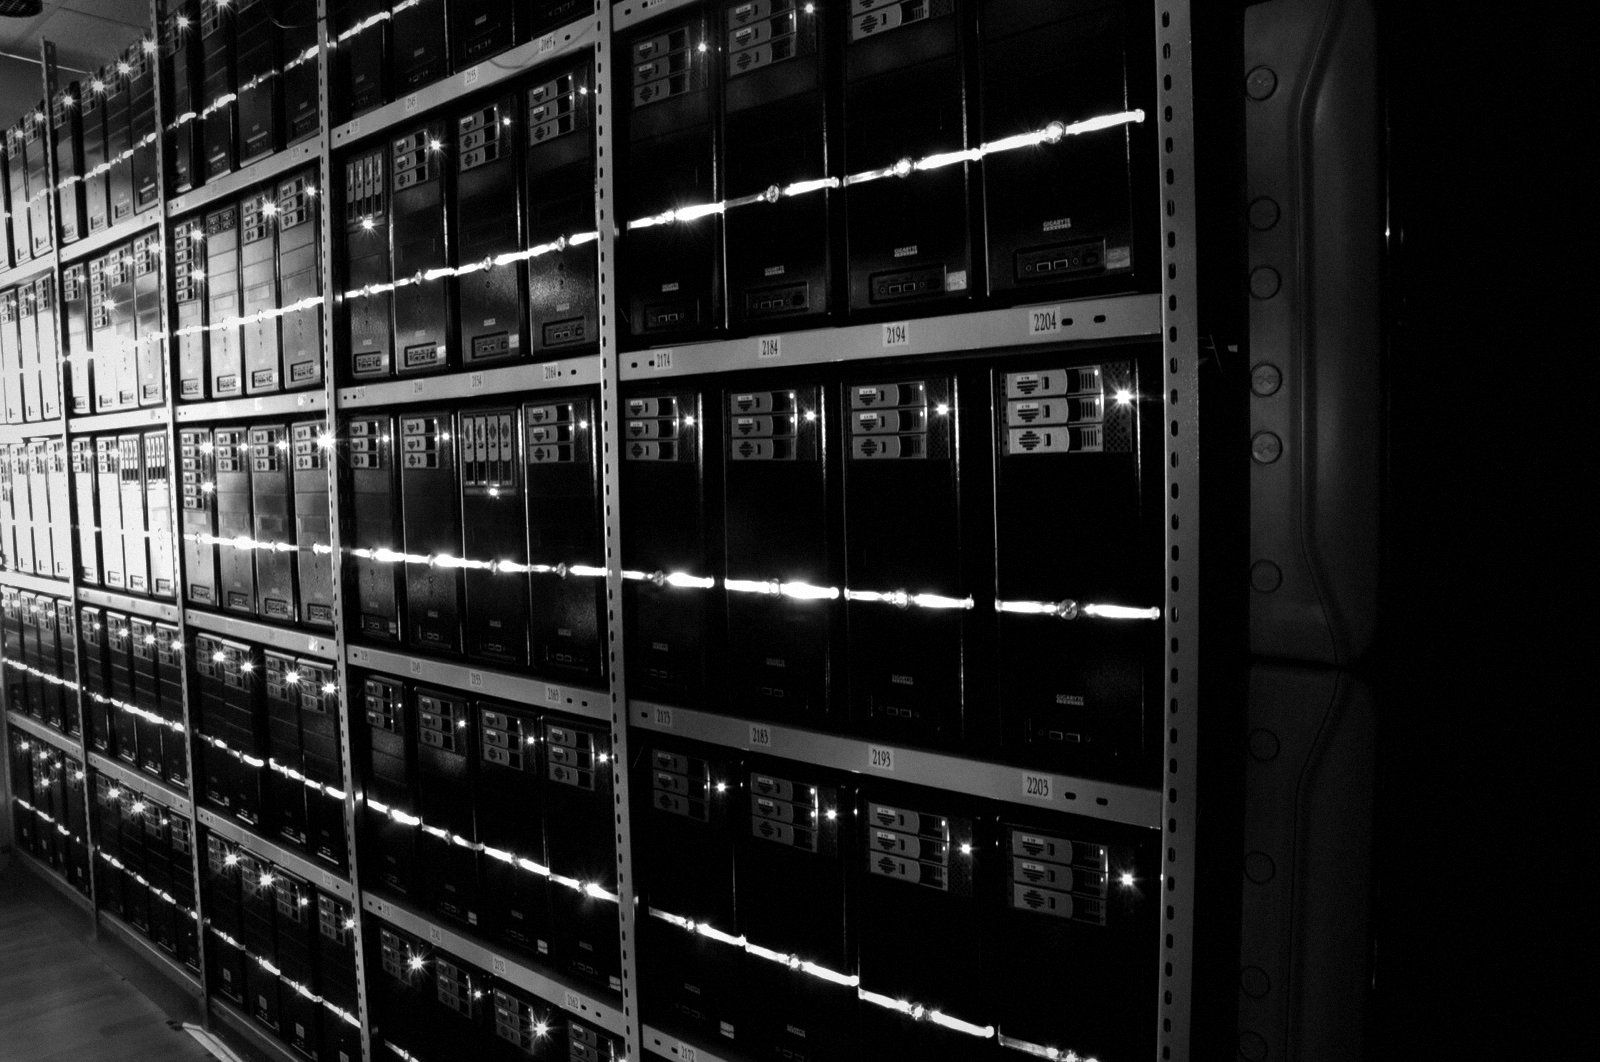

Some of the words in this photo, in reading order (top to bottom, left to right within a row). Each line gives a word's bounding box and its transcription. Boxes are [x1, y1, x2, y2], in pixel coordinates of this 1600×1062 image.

[1034, 310, 1055, 332] 2204
[887, 325, 905, 344] 2194
[761, 339, 777, 356] 2184
[656, 353, 669, 368] 2174
[751, 727, 768, 745] 2183
[872, 749, 891, 768] 2193
[1026, 776, 1048, 797] 2203
